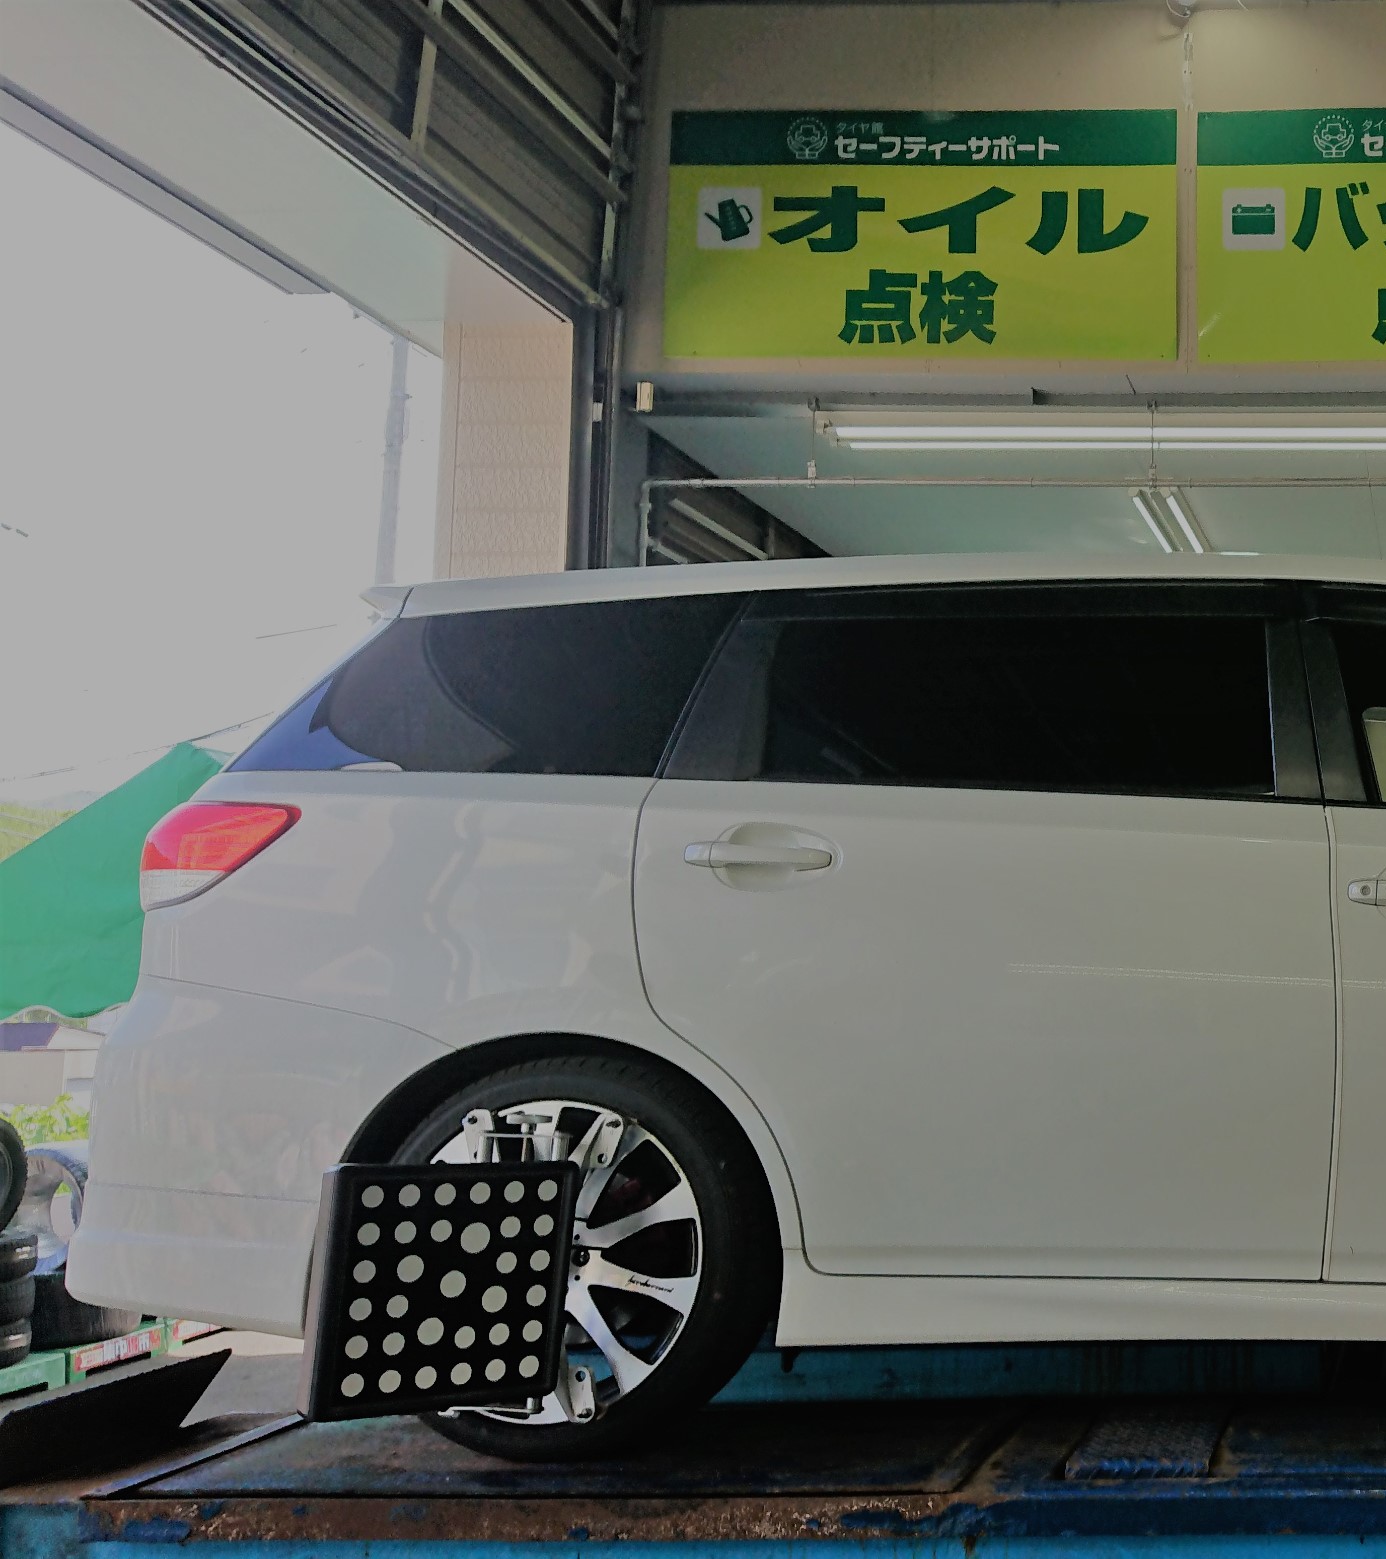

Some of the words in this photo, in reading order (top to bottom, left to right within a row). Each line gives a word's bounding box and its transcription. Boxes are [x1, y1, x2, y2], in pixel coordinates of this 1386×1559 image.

[834, 135, 1060, 162] セーフティーサポート
[836, 121, 884, 135] タイヤ館
[767, 185, 1149, 256] オイル
[837, 268, 998, 346] 点検
